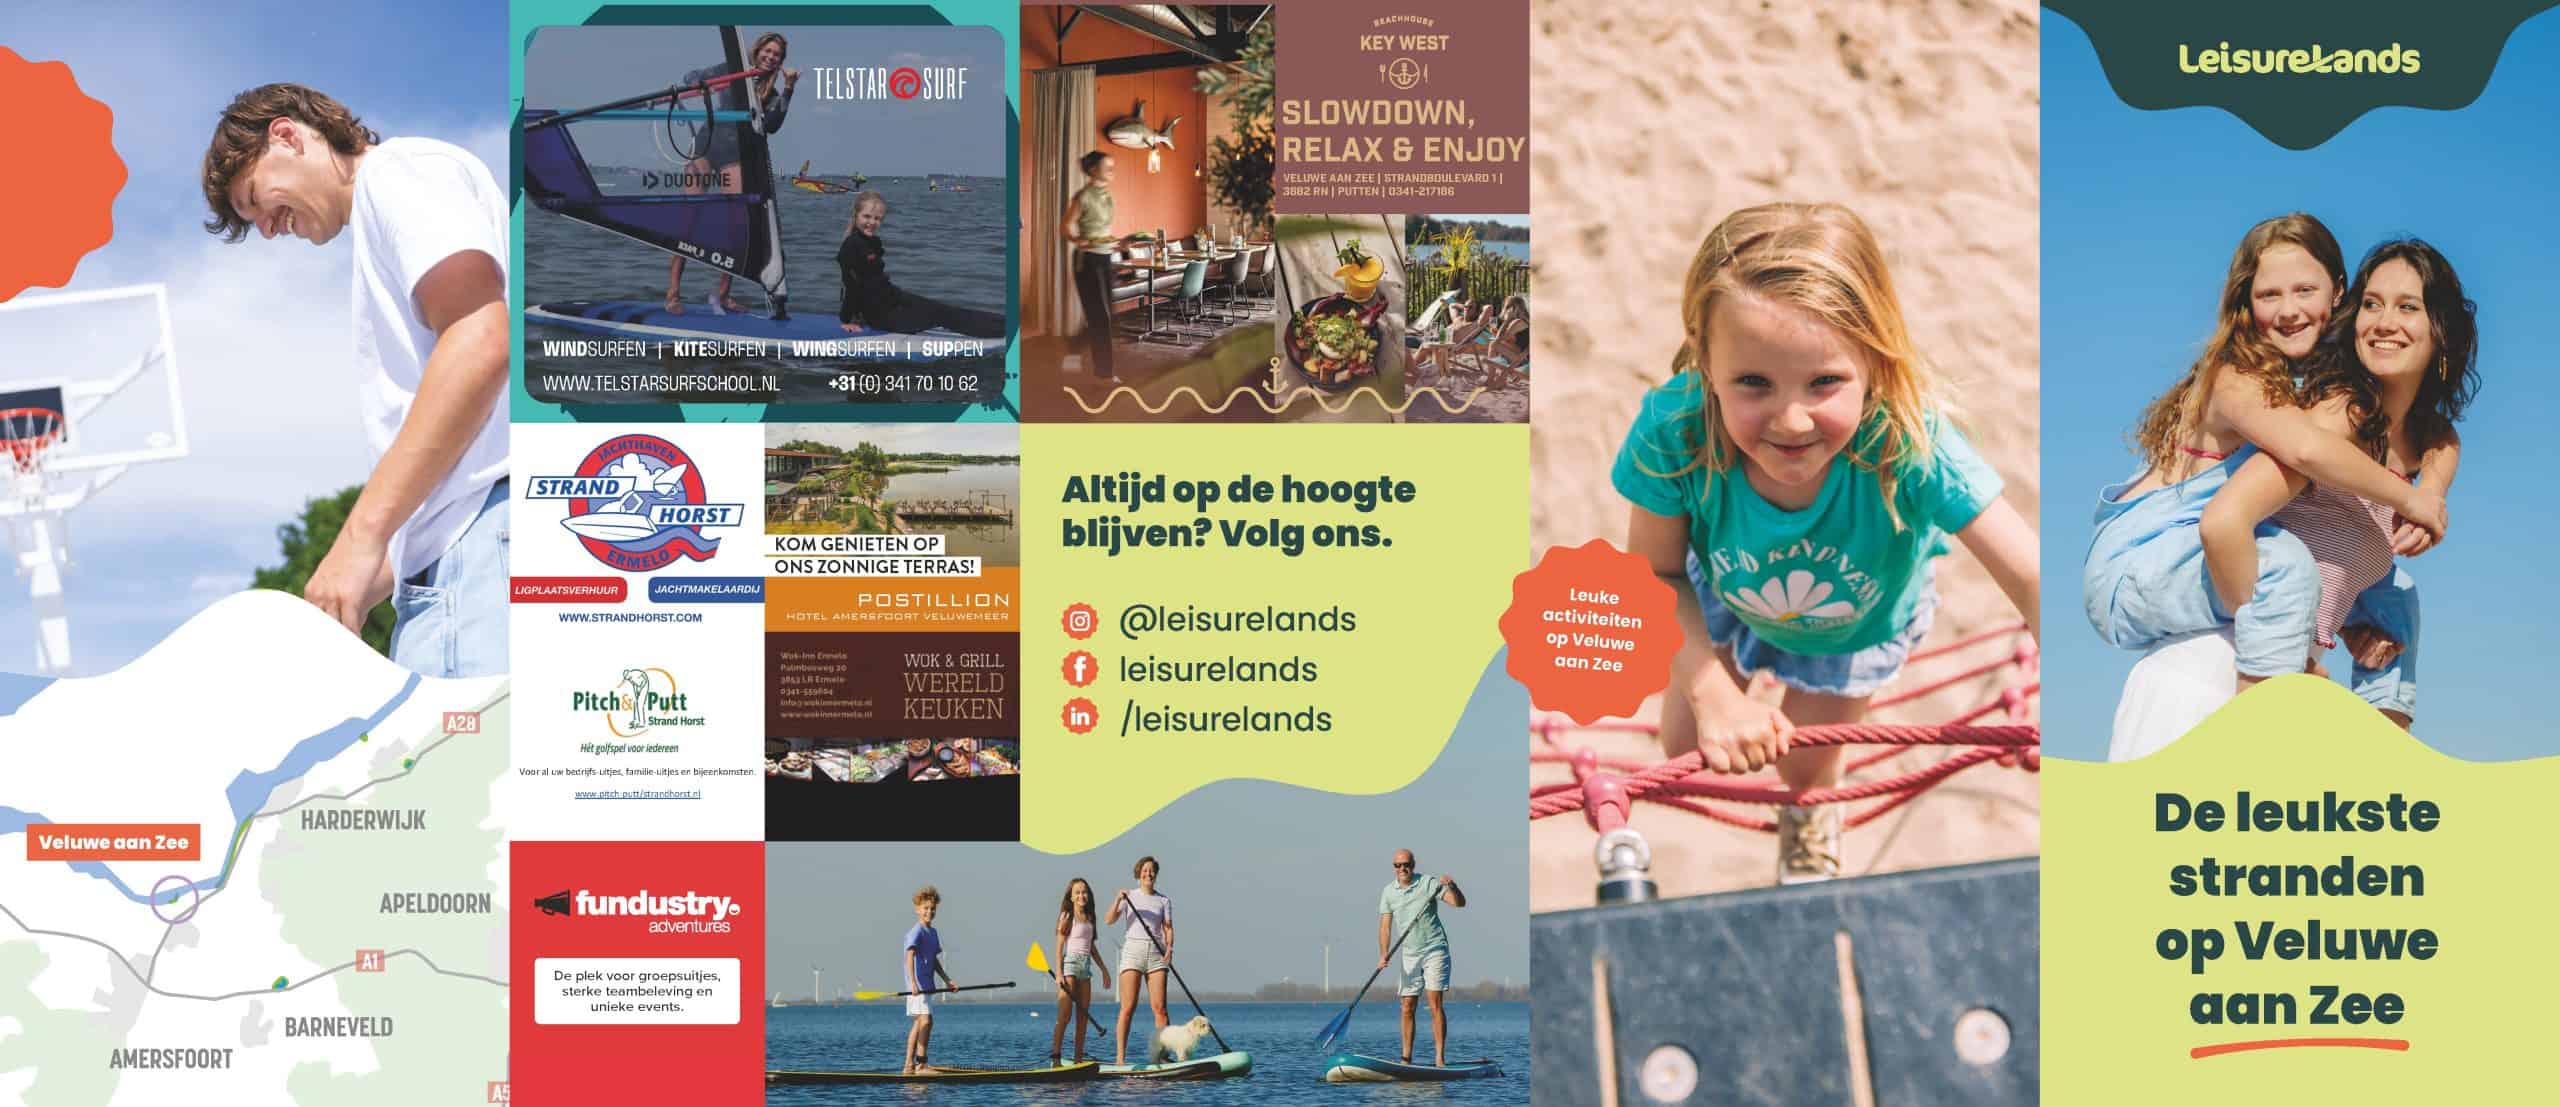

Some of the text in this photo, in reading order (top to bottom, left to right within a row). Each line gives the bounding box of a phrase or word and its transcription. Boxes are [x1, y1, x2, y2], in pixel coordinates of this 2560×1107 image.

[1373, 15, 1435, 28] BEACHHOUSE
[1360, 34, 1450, 51] KEY WEST
[812, 67, 969, 100] TELSTAR SURF
[1282, 99, 1475, 129] SLOWDOWN,
[1282, 136, 1526, 163] RELAX & ENJOY
[663, 171, 732, 189] DUOTONE
[1282, 172, 1327, 184] VELUWE
[1329, 172, 1352, 184] AAN
[1354, 172, 1375, 184] ZEE
[1383, 172, 1489, 184] STRANDBOULEVARD
[1282, 186, 1311, 197] 3882
[1337, 186, 1379, 197] PUTTEN
[543, 340, 646, 358] WINDSURFEN
[673, 340, 767, 358] KITESURFEN
[792, 340, 896, 358] WINGSURFEN
[921, 340, 984, 358] SUPPEN
[543, 375, 782, 392] WWW.TELSTARSURFSCHOOL.NL
[885, 375, 911, 392] 341
[916, 375, 933, 392] 70
[938, 375, 953, 392] 10
[958, 375, 978, 392] 62
[598, 439, 677, 462] JACHTHAVEN
[536, 479, 620, 496] STRAND
[1062, 471, 1417, 513] Altijd op de hoogte
[659, 507, 732, 523] HORST
[775, 537, 939, 552] KOM GENIETEN OP
[1062, 515, 1393, 557] blijven? Volg ons.
[607, 549, 670, 569] ERMELO
[774, 559, 975, 574] ONS ZONNIGE TERRAS!
[514, 585, 619, 596] LIGPLAATSVERHUUR
[654, 584, 761, 595] JACHTMAKELAARDIJ
[1569, 587, 1620, 605] Leuke
[858, 593, 1009, 607] POSTILLION
[559, 612, 703, 623] WWW.STRANDHORST.COM
[786, 612, 1009, 621] HOTEL AMERSFOORT VELUWEMEER
[1120, 604, 1357, 640] @leisurelands
[1542, 608, 1643, 630] activiteiten
[1546, 631, 1635, 651] op Veluwe
[904, 653, 1005, 668] WOK & GRILL
[1120, 655, 1318, 682] leisurelands
[1554, 655, 1624, 672] aan Zee
[904, 672, 1004, 693] WERELD
[647, 691, 688, 712] Putt
[904, 697, 1004, 720] KEUKEN
[446, 715, 477, 732] A28
[648, 716, 705, 726] Strand Horst
[1120, 698, 1333, 738] /leisurelands
[595, 742, 627, 756] golfspel
[628, 744, 644, 753] voor
[646, 742, 680, 753] iedereen
[519, 767, 540, 777] Voor
[551, 768, 564, 777] uw
[680, 768, 692, 777] en
[301, 809, 427, 831] HARDERWIJK
[2155, 791, 2441, 833] De leukste
[38, 834, 190, 850] Veluwe aan Zee
[2168, 855, 2425, 897] stranden
[379, 892, 492, 914] APELDOORN
[648, 919, 731, 933] adventures
[2155, 919, 2440, 976] op Veluwe
[362, 952, 379, 971] A1
[553, 969, 721, 984] De plek voor groepsuitjes,
[561, 985, 713, 999] sterke teambeleving en
[590, 1000, 685, 1012] unieke events.
[2189, 985, 2406, 1026] aan Zee
[285, 1016, 394, 1038] BARNEVELD
[109, 1047, 234, 1069] AMERSFOORT
